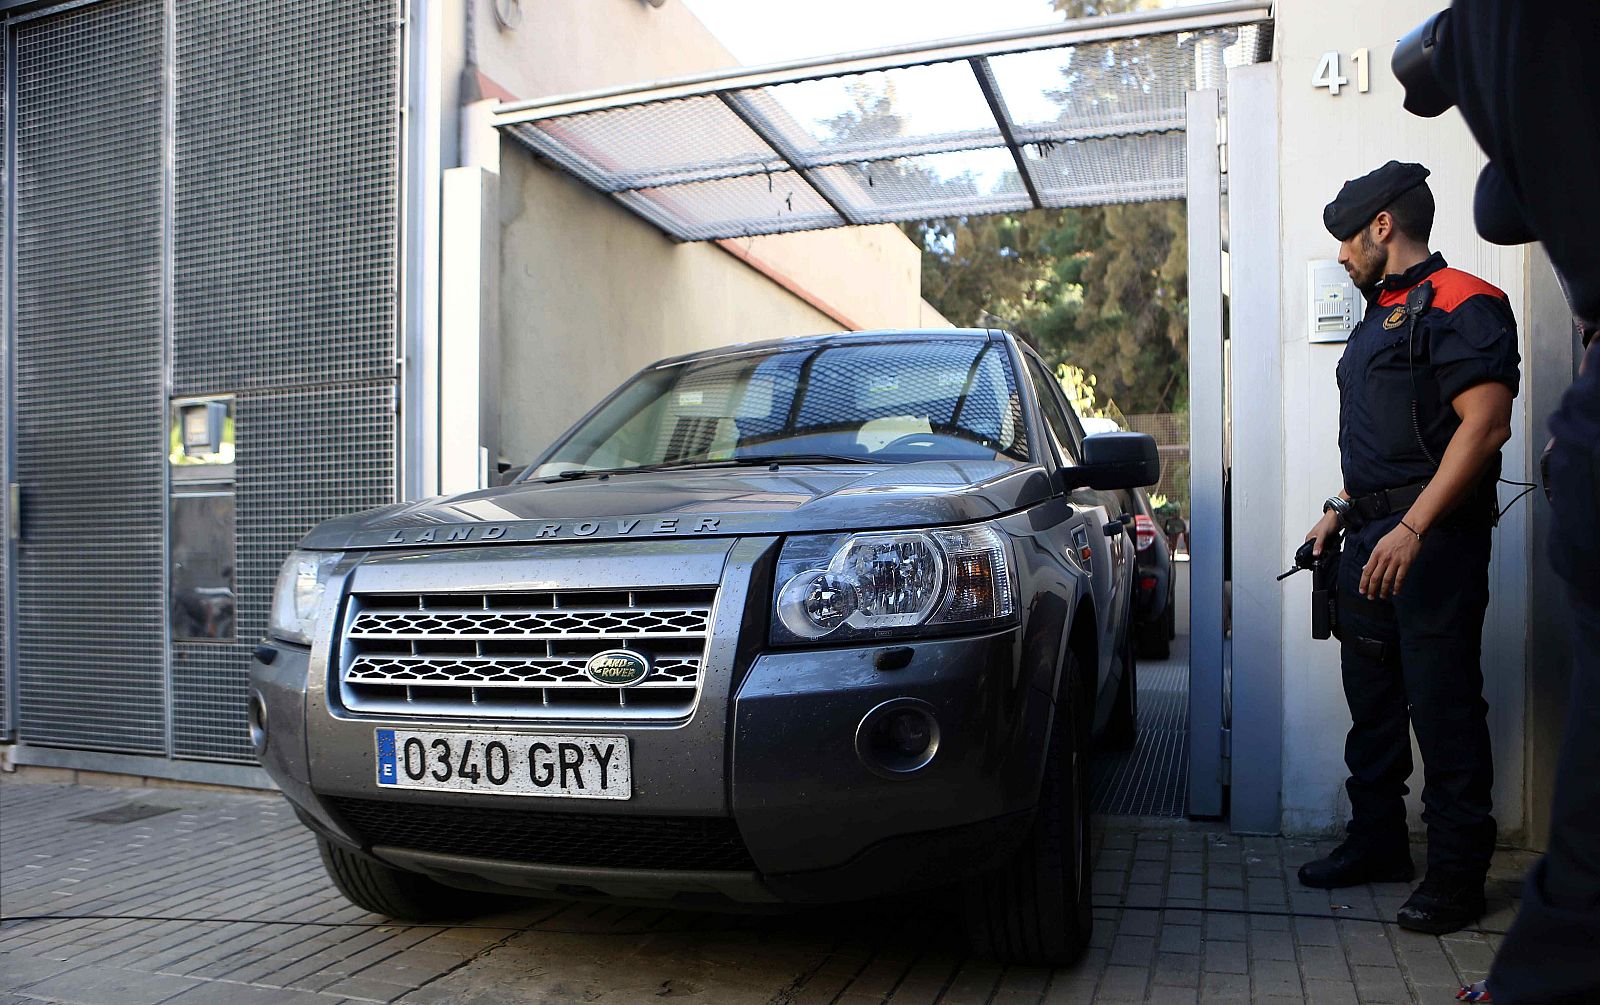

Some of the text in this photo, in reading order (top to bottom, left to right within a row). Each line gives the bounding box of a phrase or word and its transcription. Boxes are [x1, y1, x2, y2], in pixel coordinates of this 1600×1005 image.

[1311, 47, 1369, 96] 41
[386, 517, 721, 544] LAND ROVER
[601, 667, 636, 677] ROVER
[383, 763, 393, 776] E
[403, 736, 615, 790] 0340 GRY
